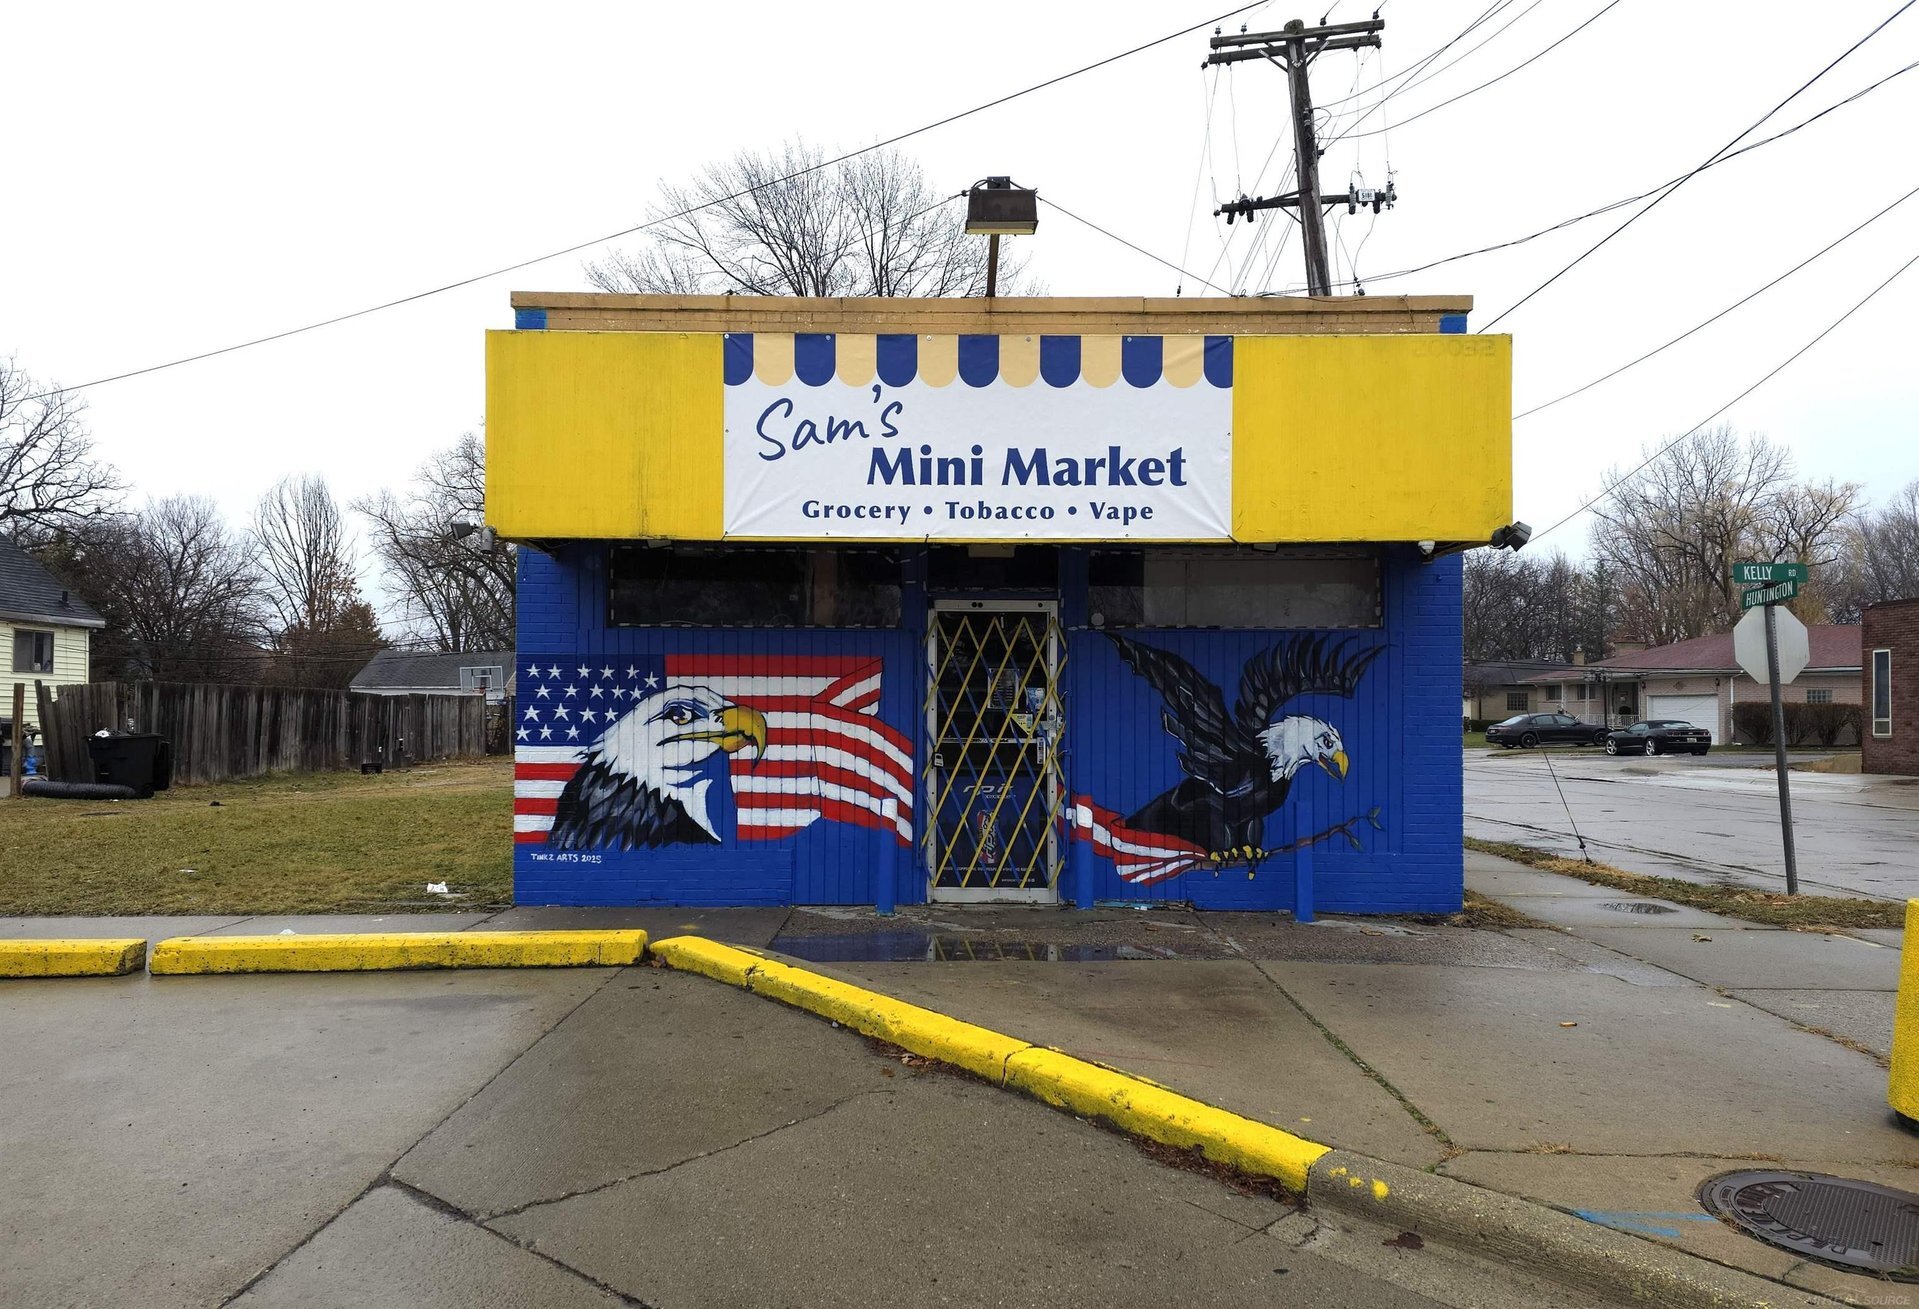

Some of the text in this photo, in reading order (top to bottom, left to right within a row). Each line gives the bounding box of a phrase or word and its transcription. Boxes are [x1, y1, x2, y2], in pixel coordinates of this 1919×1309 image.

[755, 384, 903, 462] Sam's
[867, 444, 1187, 487] Mini Market
[803, 500, 1154, 526] Grocery Tobacco Vape
[1743, 566, 1773, 580] KELLY
[1745, 581, 1793, 606] HUNTINGTON
[556, 854, 578, 863] ARTS
[581, 854, 602, 863] 2025
